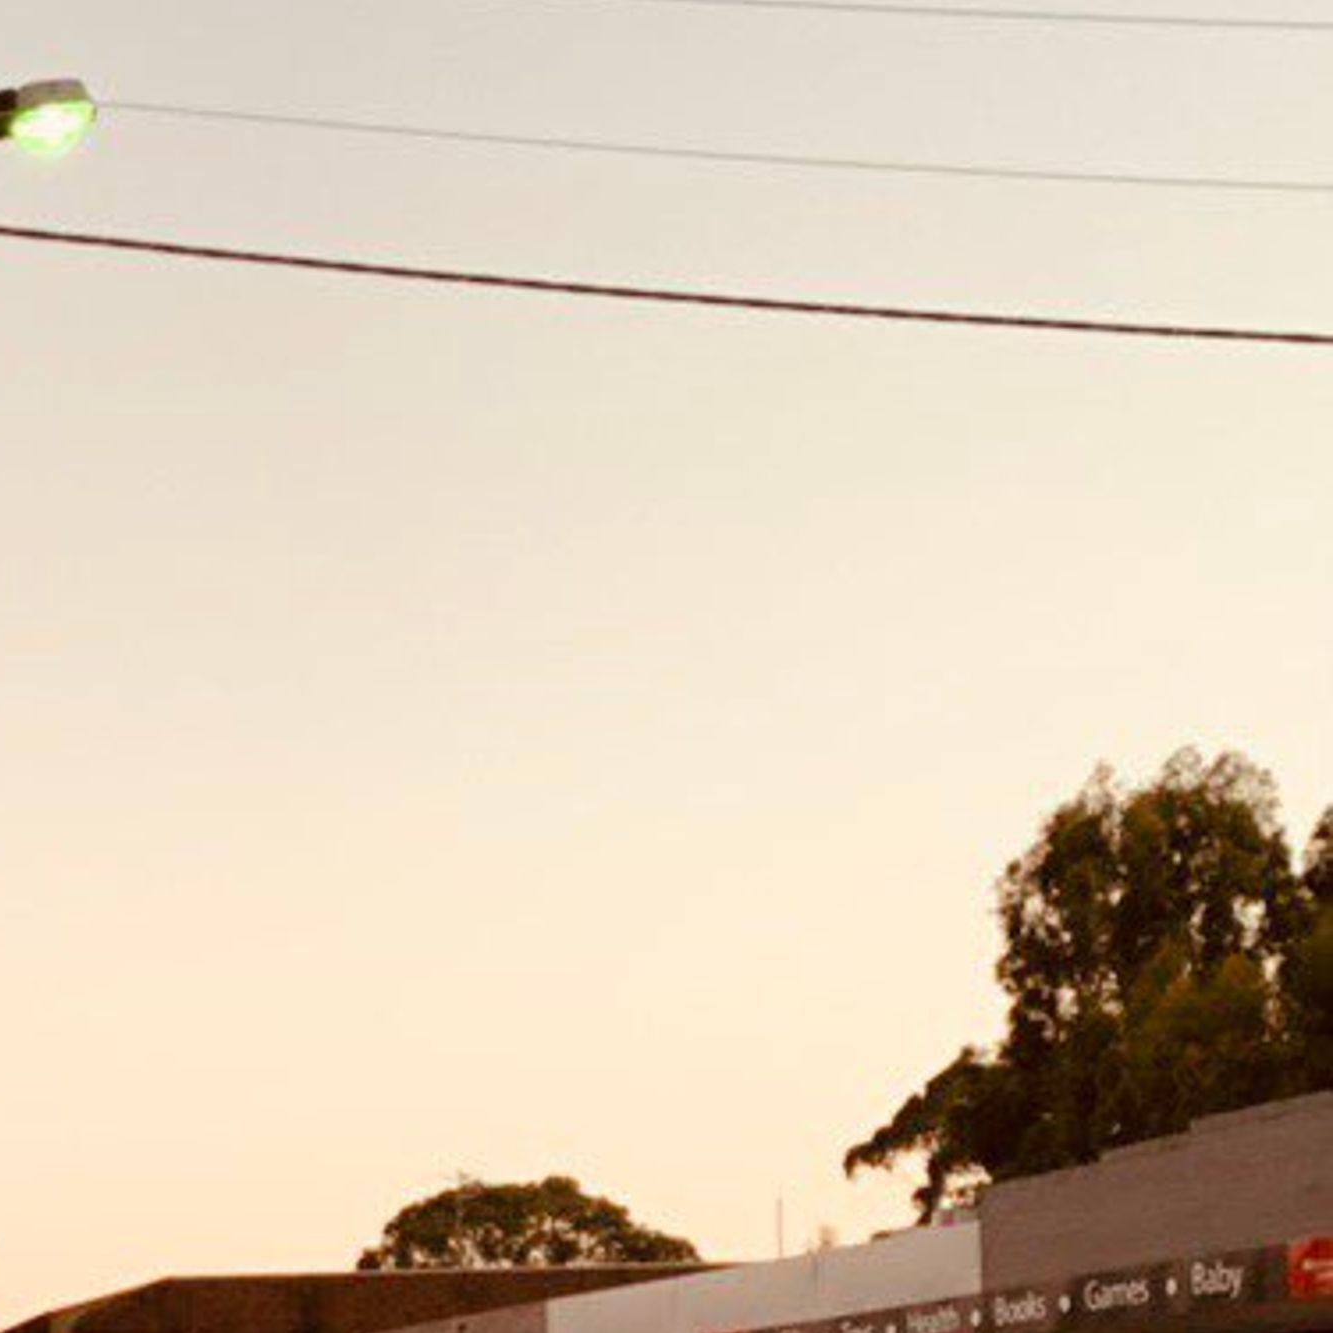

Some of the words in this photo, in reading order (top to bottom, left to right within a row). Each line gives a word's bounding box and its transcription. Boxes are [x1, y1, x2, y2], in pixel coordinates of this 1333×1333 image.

[994, 1291, 1046, 1326] Books
[1084, 1279, 1149, 1311] Games
[1191, 1261, 1244, 1298] Baby
